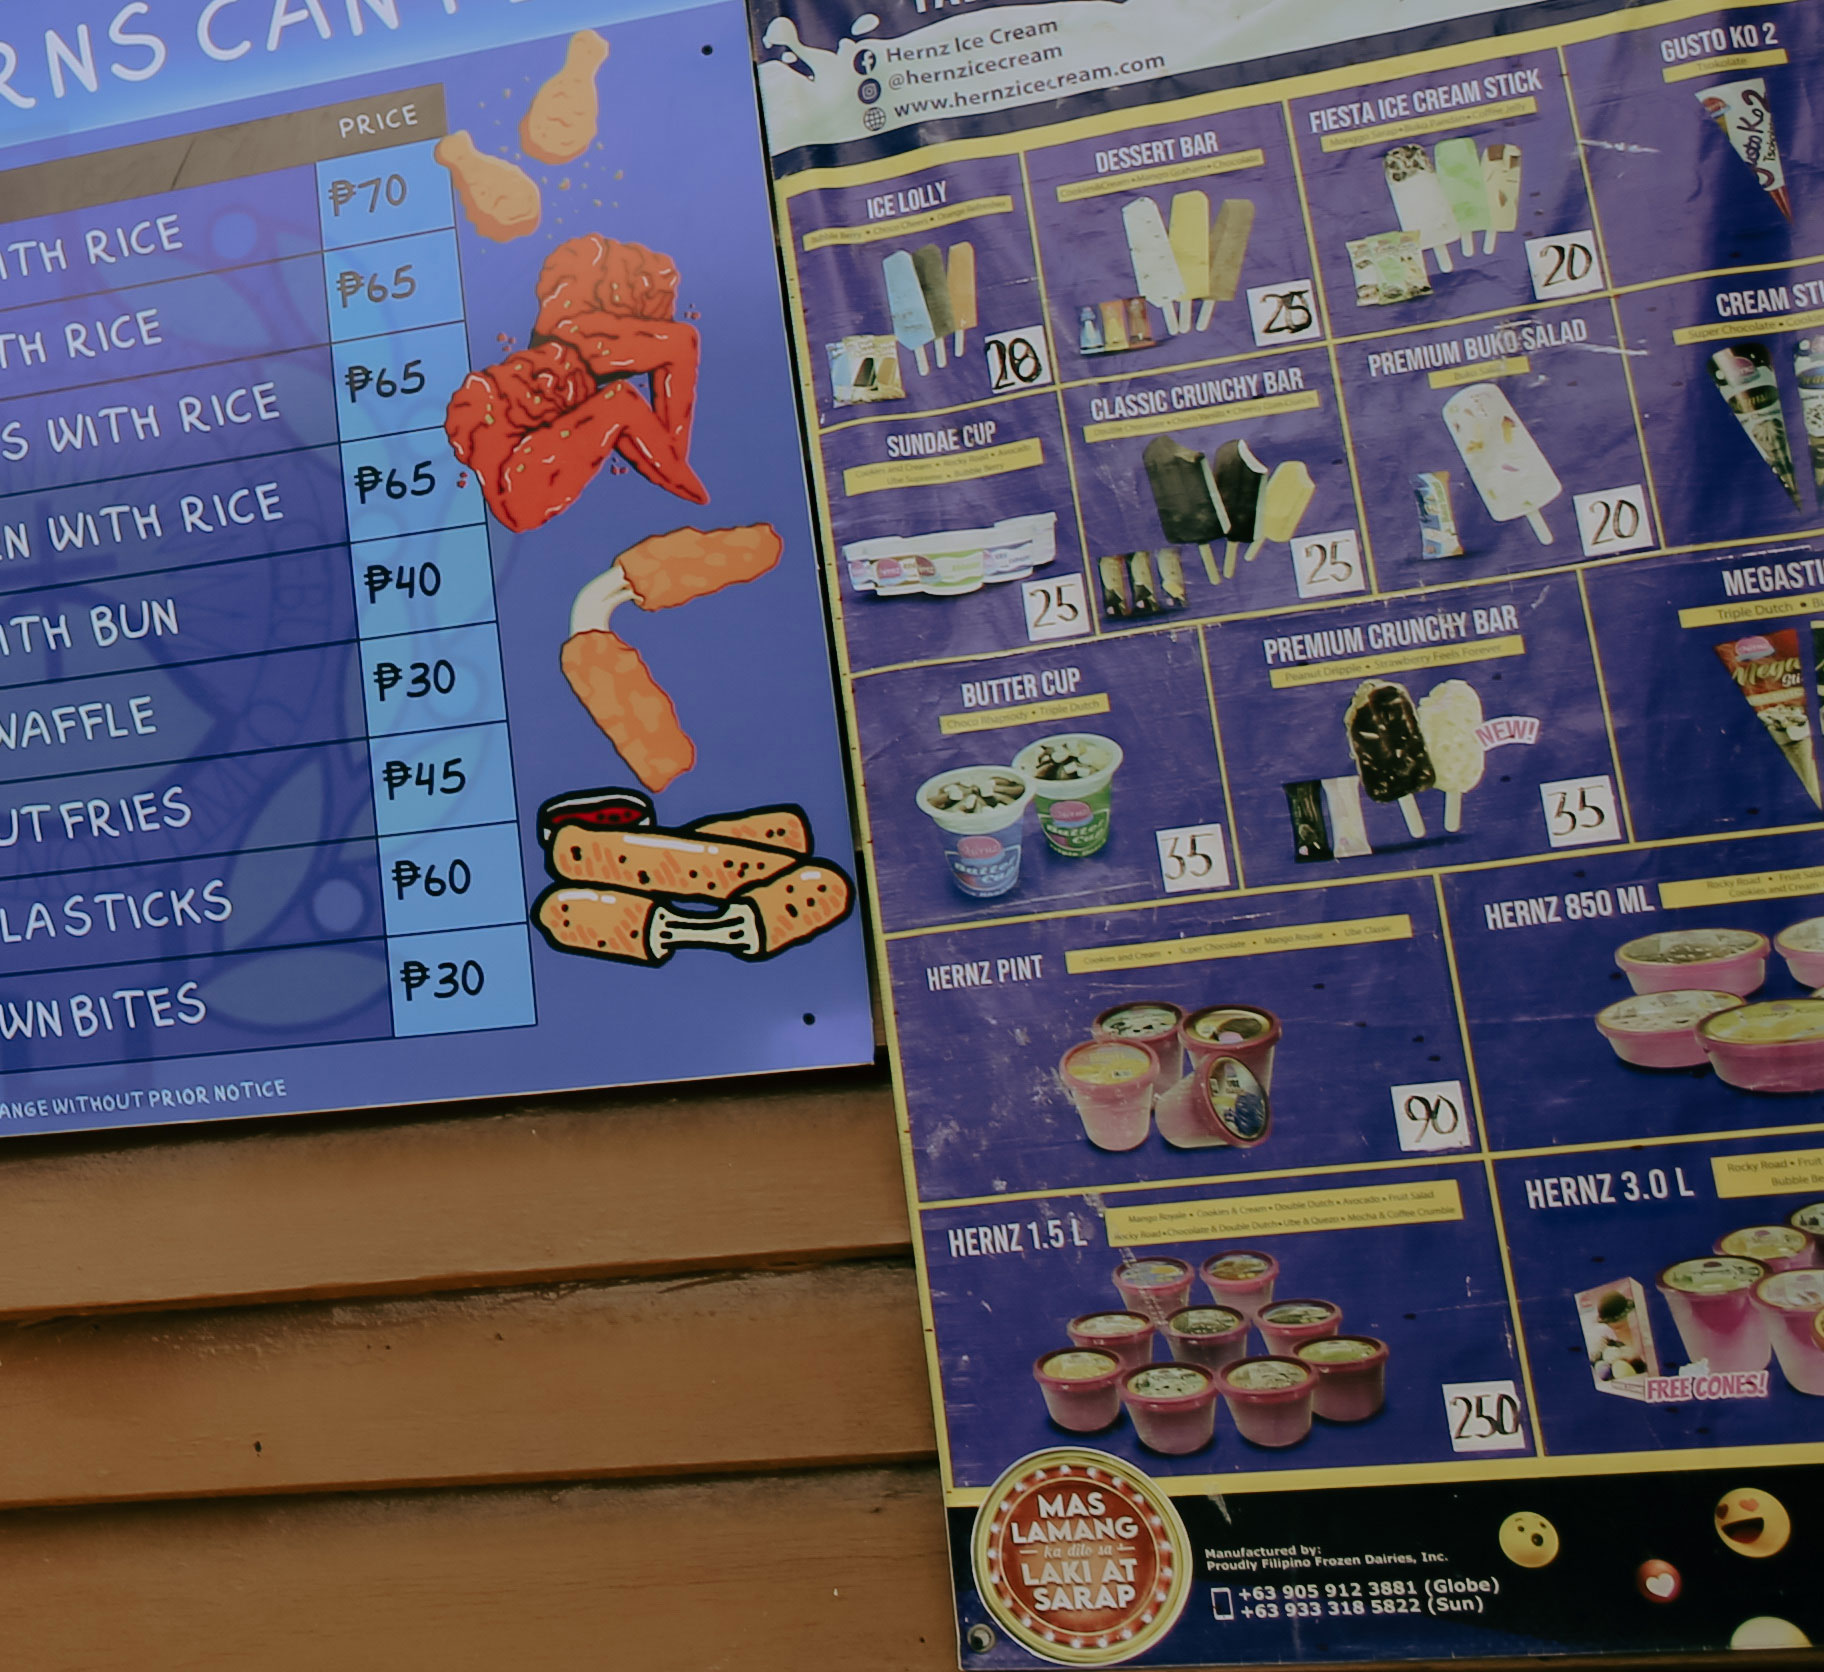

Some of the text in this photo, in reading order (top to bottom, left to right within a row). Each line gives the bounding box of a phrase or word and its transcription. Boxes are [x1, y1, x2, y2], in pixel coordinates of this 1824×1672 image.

[887, 18, 1059, 64] Hernz Ice Cream
[1660, 22, 1777, 63] GUSTO KO 2
[887, 44, 1063, 91] @hernzicecream
[894, 54, 1165, 119] www.hernzicecream.com
[339, 104, 418, 138] PRICE
[1308, 67, 1542, 135] FIESTA ICE CREAM STICK
[1095, 140, 1177, 173] DESSERT
[1180, 131, 1219, 158] BAR
[866, 194, 896, 220] ICE
[900, 180, 947, 214] LOLLY
[85, 214, 183, 266] RICE
[1538, 243, 1593, 287] 20
[1715, 287, 1790, 318] CREAM
[64, 308, 162, 358] RICE
[1367, 340, 1461, 378] PREMIUM
[1464, 330, 1518, 363] BUKO
[1522, 318, 1588, 350] SALAD
[1090, 388, 1168, 421] CLASSIC
[1171, 374, 1262, 411] CRUNCHY
[1264, 366, 1304, 394] BAR
[46, 402, 161, 454] WITH
[178, 381, 280, 434] RICE
[886, 421, 997, 459] SUNDAE CUP
[48, 504, 161, 553] WITH
[180, 482, 284, 535] RICE
[1590, 498, 1640, 545] 20
[1304, 539, 1353, 584] 25
[1721, 558, 1824, 597] MEGASTI
[89, 598, 179, 648] BUN
[1029, 588, 1079, 628] 25
[1717, 602, 1793, 621] Triple Dutch
[1263, 604, 1519, 665] PREMIUM CRUNCHY BAR
[961, 667, 1082, 708] BUTTER CUP
[1475, 717, 1538, 748] NEW!
[1546, 785, 1605, 836] 35
[1160, 832, 1216, 881] 35
[1484, 885, 1655, 930] HERNZ 850 ML
[926, 954, 1043, 992] HERNZ PINT
[52, 1091, 144, 1114] WITHOUT
[149, 1087, 209, 1108] PRIOR
[214, 1079, 287, 1102] NOTICE
[1404, 1094, 1458, 1143] 90
[1525, 1167, 1695, 1209] HERNZ 3.0 L
[948, 1218, 1088, 1257] HERNZ 1.5 L
[1647, 1372, 1768, 1400] FREE CONES!
[1452, 1393, 1521, 1439] 250
[1037, 1492, 1106, 1518] MAS
[1011, 1516, 1138, 1544] LAMANG
[1021, 1558, 1137, 1586] LAKI AT
[1204, 1544, 1321, 1559] Manufactured by:
[1207, 1551, 1449, 1572] Proudly Filipino Frozen Dairies, Inc.
[1033, 1584, 1136, 1611] SARAP
[1238, 1576, 1500, 1601] +63 905 912 3881 (Globe)
[1240, 1595, 1484, 1618] +63 933 318 5822 (Sun)
